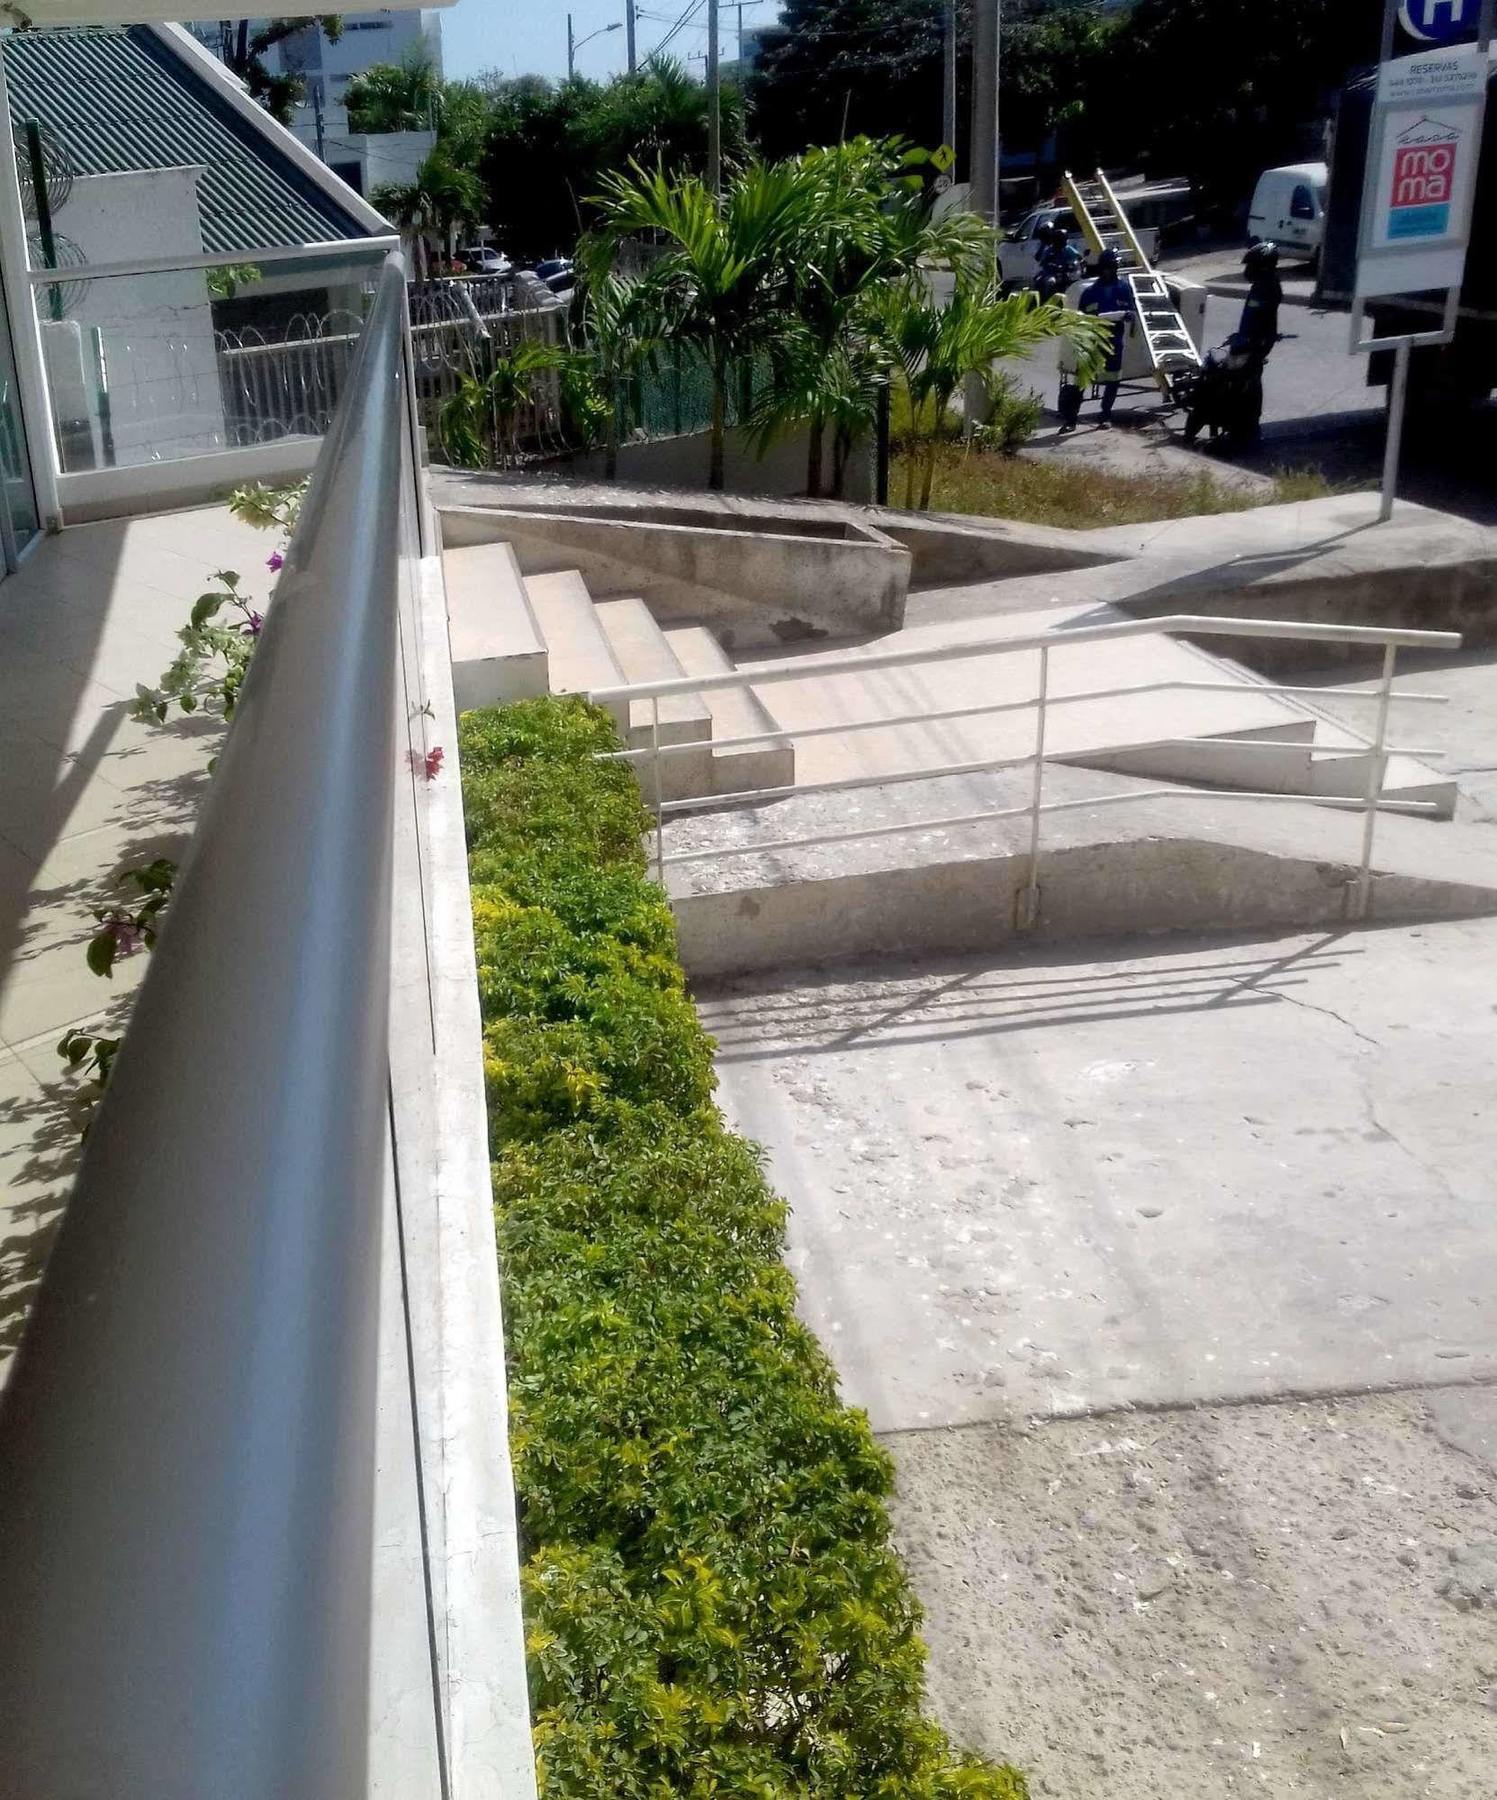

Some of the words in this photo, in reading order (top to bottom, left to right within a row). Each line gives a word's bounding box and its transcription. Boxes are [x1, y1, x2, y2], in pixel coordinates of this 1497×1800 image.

[1409, 60, 1459, 74] RESERVAS
[1401, 148, 1451, 177] mo
[1397, 174, 1446, 202] ma
